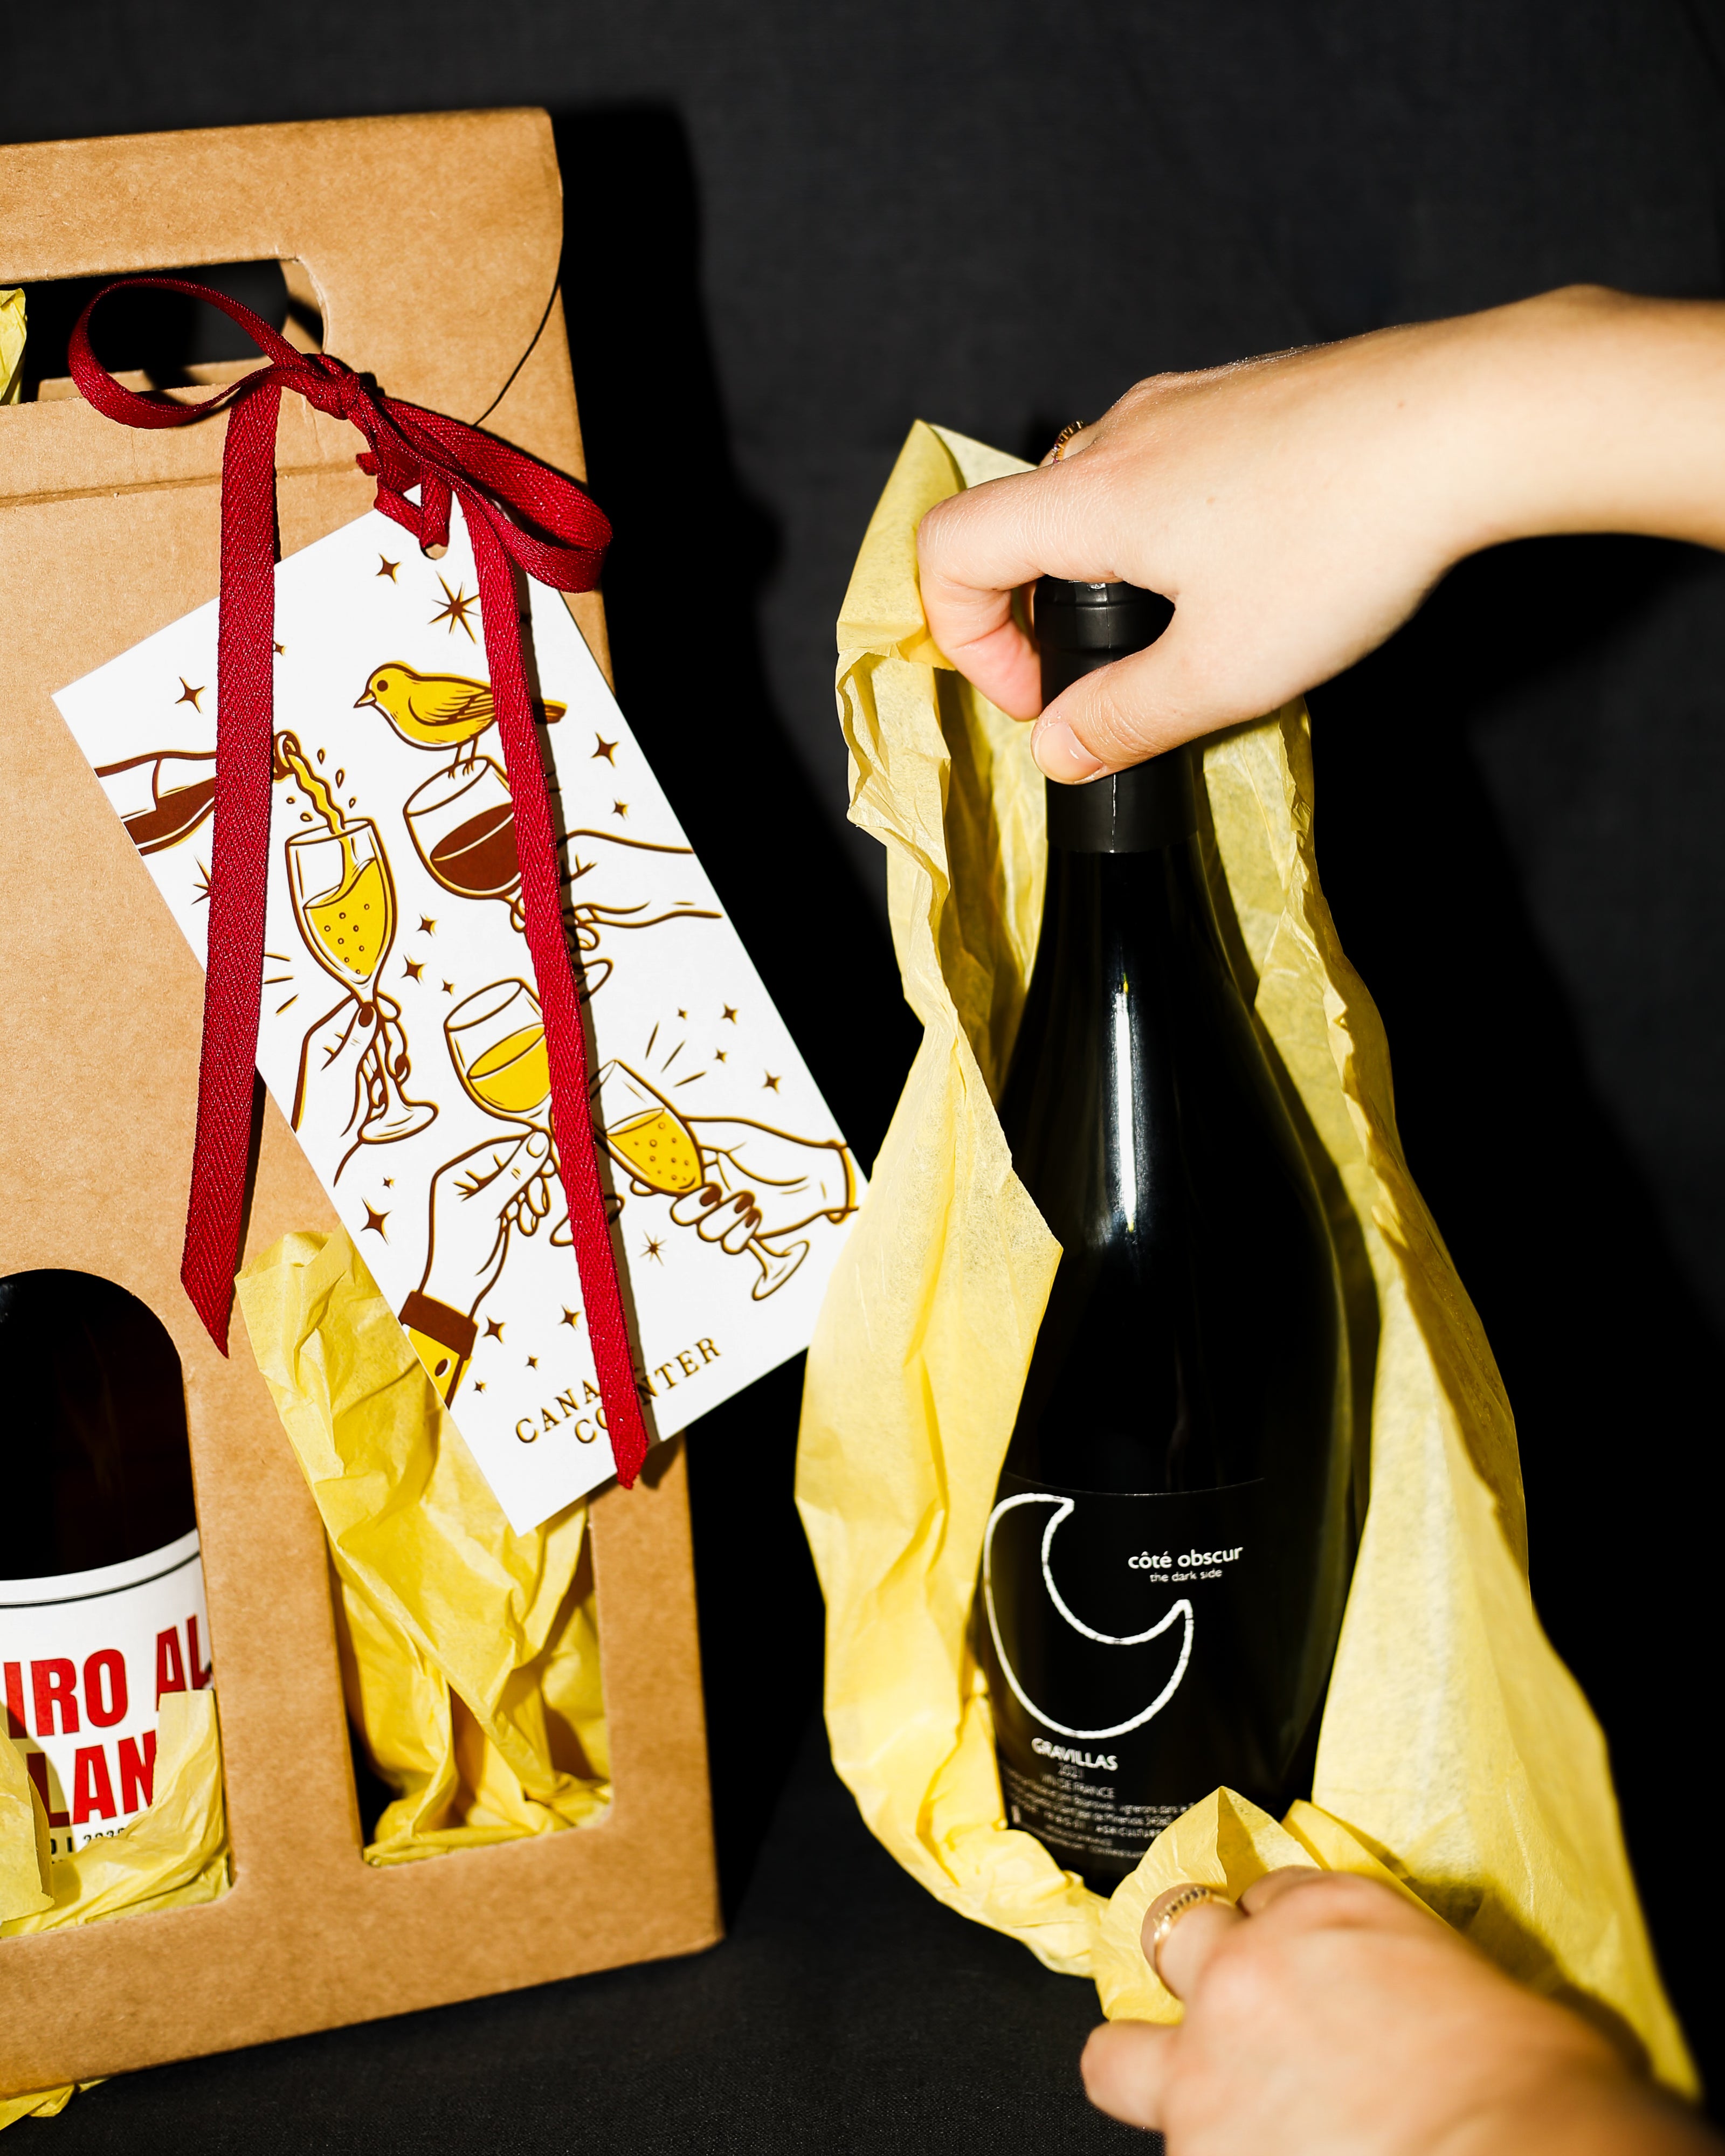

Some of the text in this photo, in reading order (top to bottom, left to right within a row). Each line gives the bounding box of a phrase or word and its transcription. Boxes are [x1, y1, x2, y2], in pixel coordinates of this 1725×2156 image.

[575, 1337, 721, 1444] CONTER
[1128, 1547, 1243, 1569] côté obscur
[1149, 1568, 1223, 1583] the dark side
[1031, 1737, 1119, 1771] GRAVILLAS
